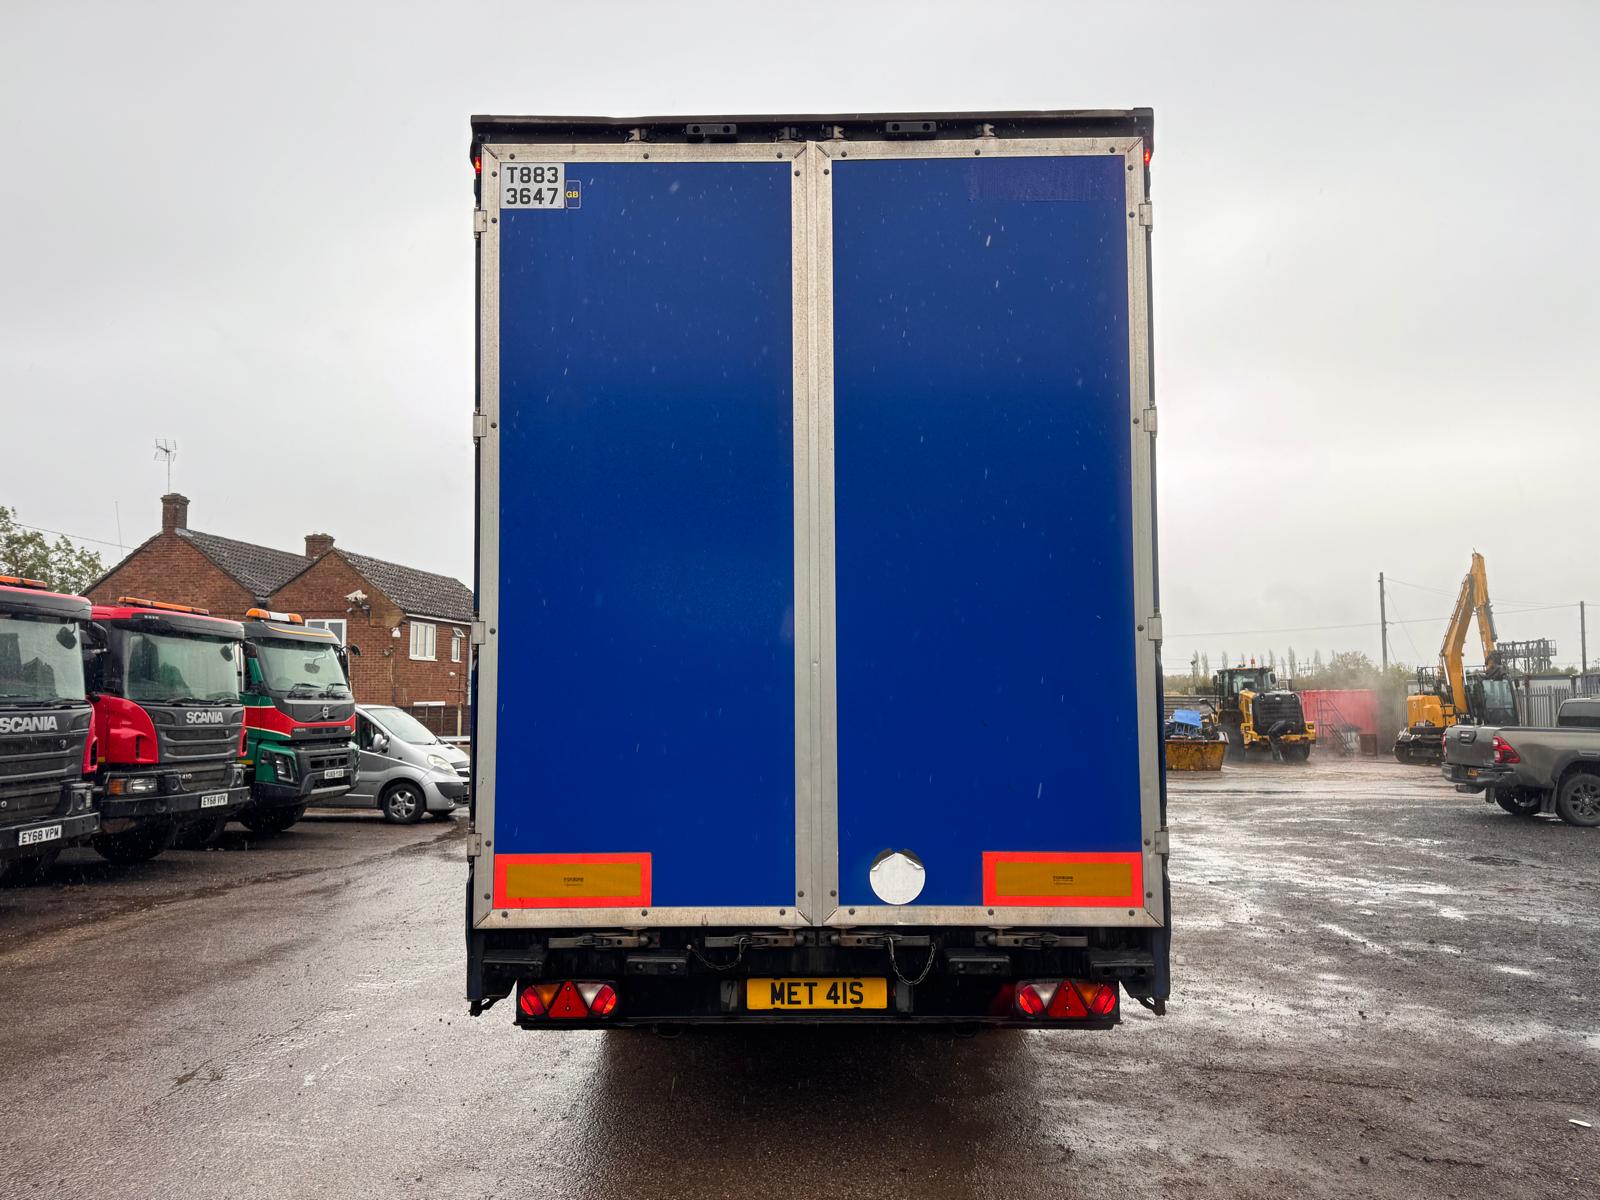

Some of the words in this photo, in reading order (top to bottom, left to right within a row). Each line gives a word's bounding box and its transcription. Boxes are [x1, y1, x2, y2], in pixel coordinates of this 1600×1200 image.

[506, 166, 558, 184] T883
[506, 187, 558, 205] 3647
[566, 191, 579, 199] GB
[0, 716, 58, 733] SCANIA
[186, 711, 224, 724] SCANIA
[21, 830, 43, 844] EY68
[771, 982, 817, 1005] MET
[826, 982, 864, 1005] 41S
